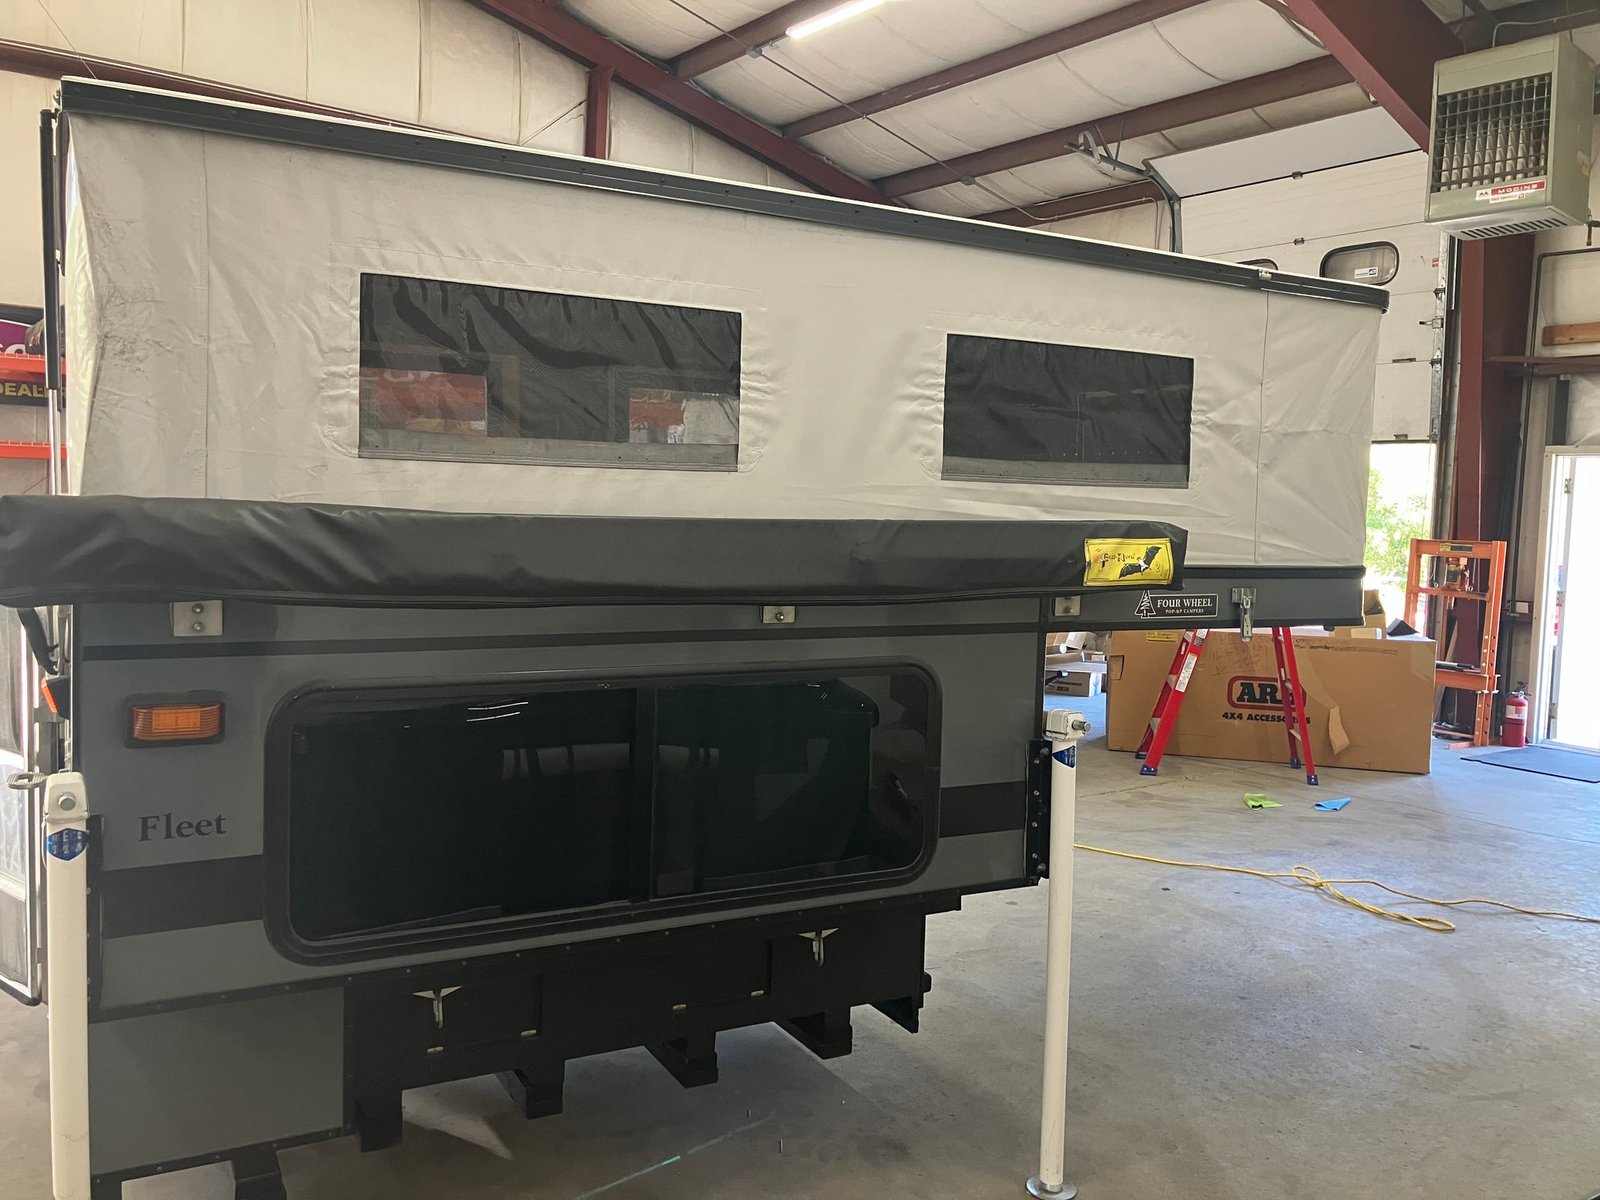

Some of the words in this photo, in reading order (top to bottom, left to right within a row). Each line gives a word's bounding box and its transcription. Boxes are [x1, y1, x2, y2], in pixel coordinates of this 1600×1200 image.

[1157, 599, 1181, 608] FOUR
[1183, 598, 1213, 607] WHEEL
[1222, 711, 1243, 720] 4X4
[138, 812, 227, 842] Fleet
